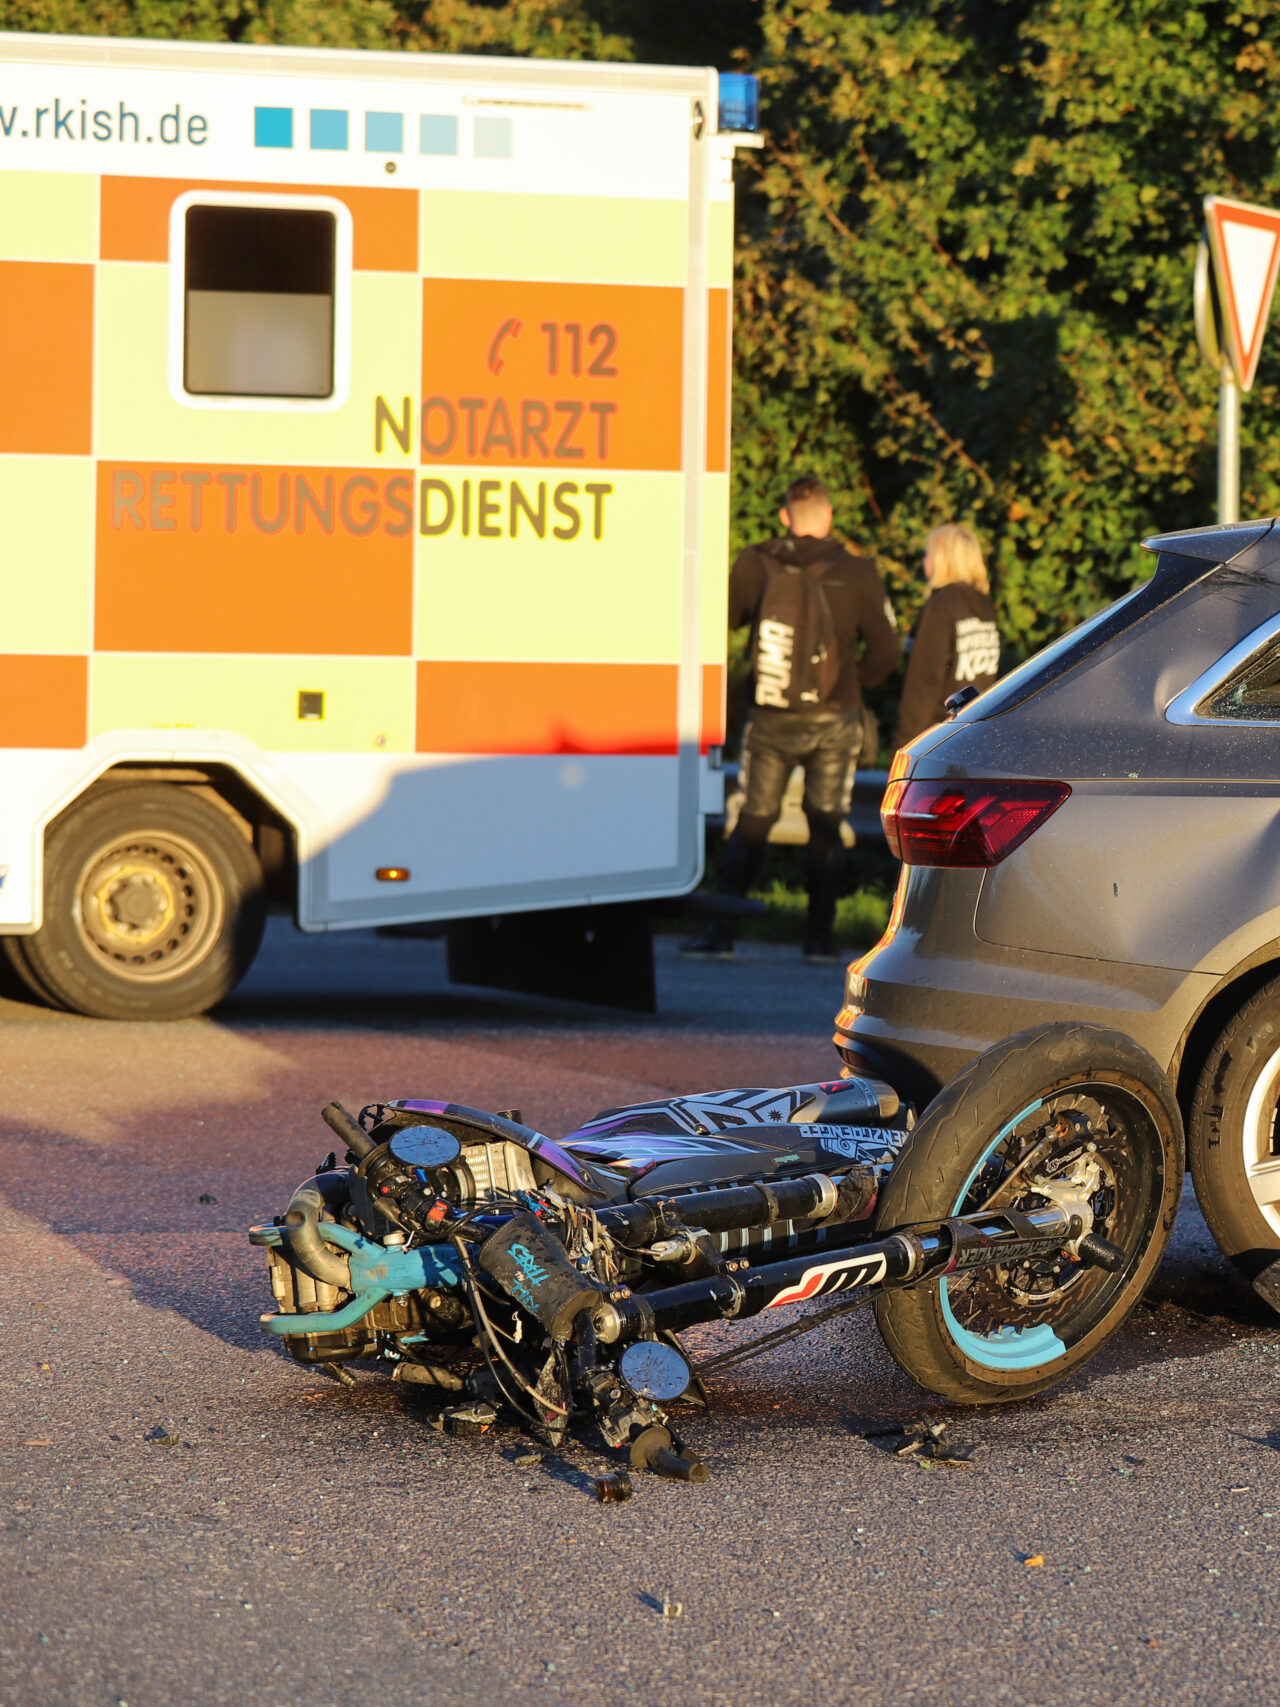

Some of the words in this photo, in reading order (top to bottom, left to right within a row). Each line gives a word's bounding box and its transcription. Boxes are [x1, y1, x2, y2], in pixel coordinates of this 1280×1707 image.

[541, 322, 618, 377] 112
[375, 395, 618, 460] NOTARZT
[111, 468, 614, 541] RETTUNGSDIENST
[755, 619, 794, 708] PUMA
[506, 1243, 550, 1287] TIRES
